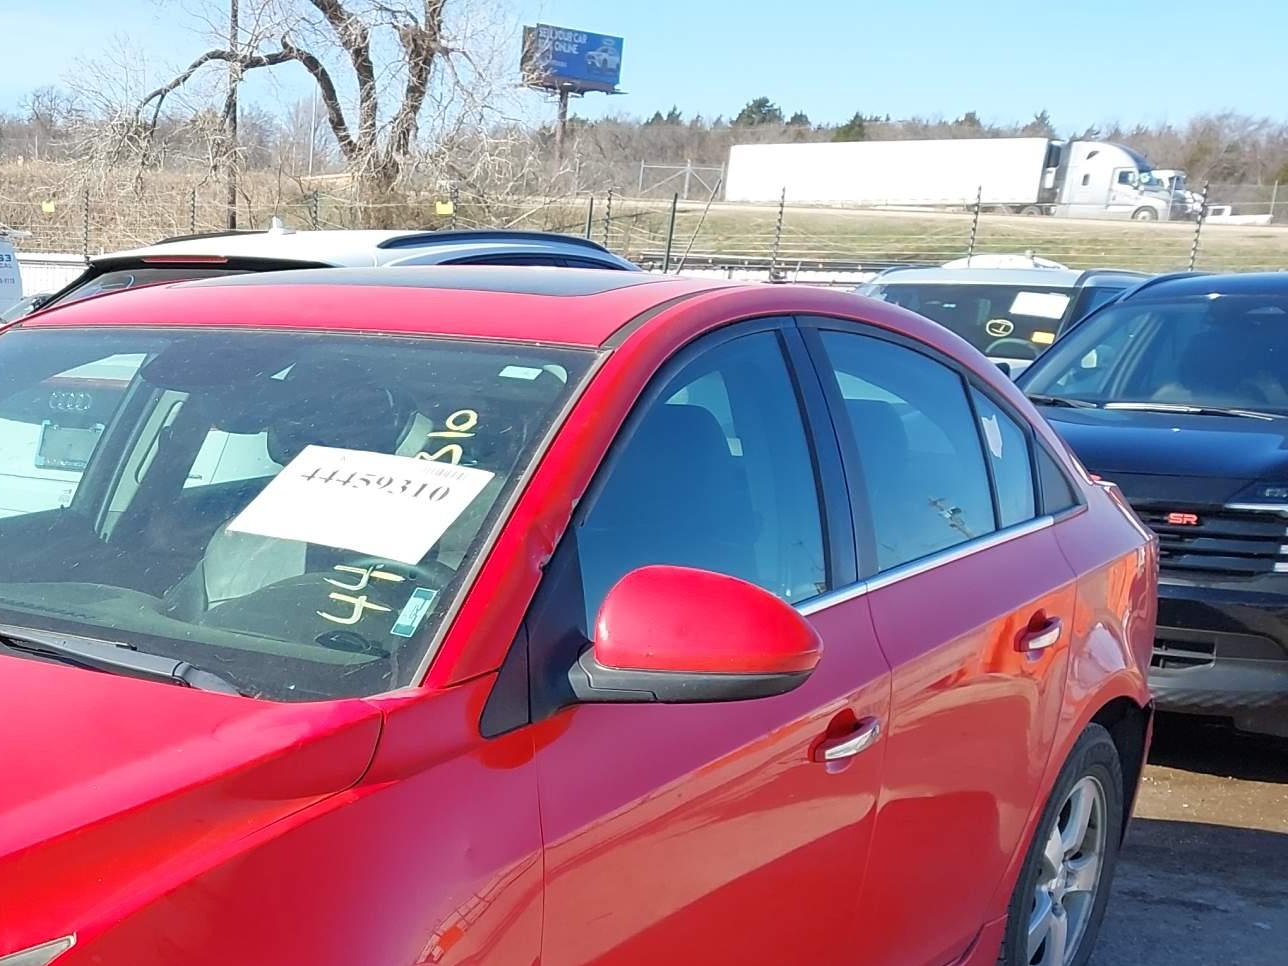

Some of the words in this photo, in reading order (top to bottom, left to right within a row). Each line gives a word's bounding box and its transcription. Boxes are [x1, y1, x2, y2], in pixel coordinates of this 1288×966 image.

[573, 33, 588, 44] CAR
[554, 41, 580, 54] ONLINE
[300, 467, 452, 502] 44459310
[1168, 512, 1198, 525] SR
